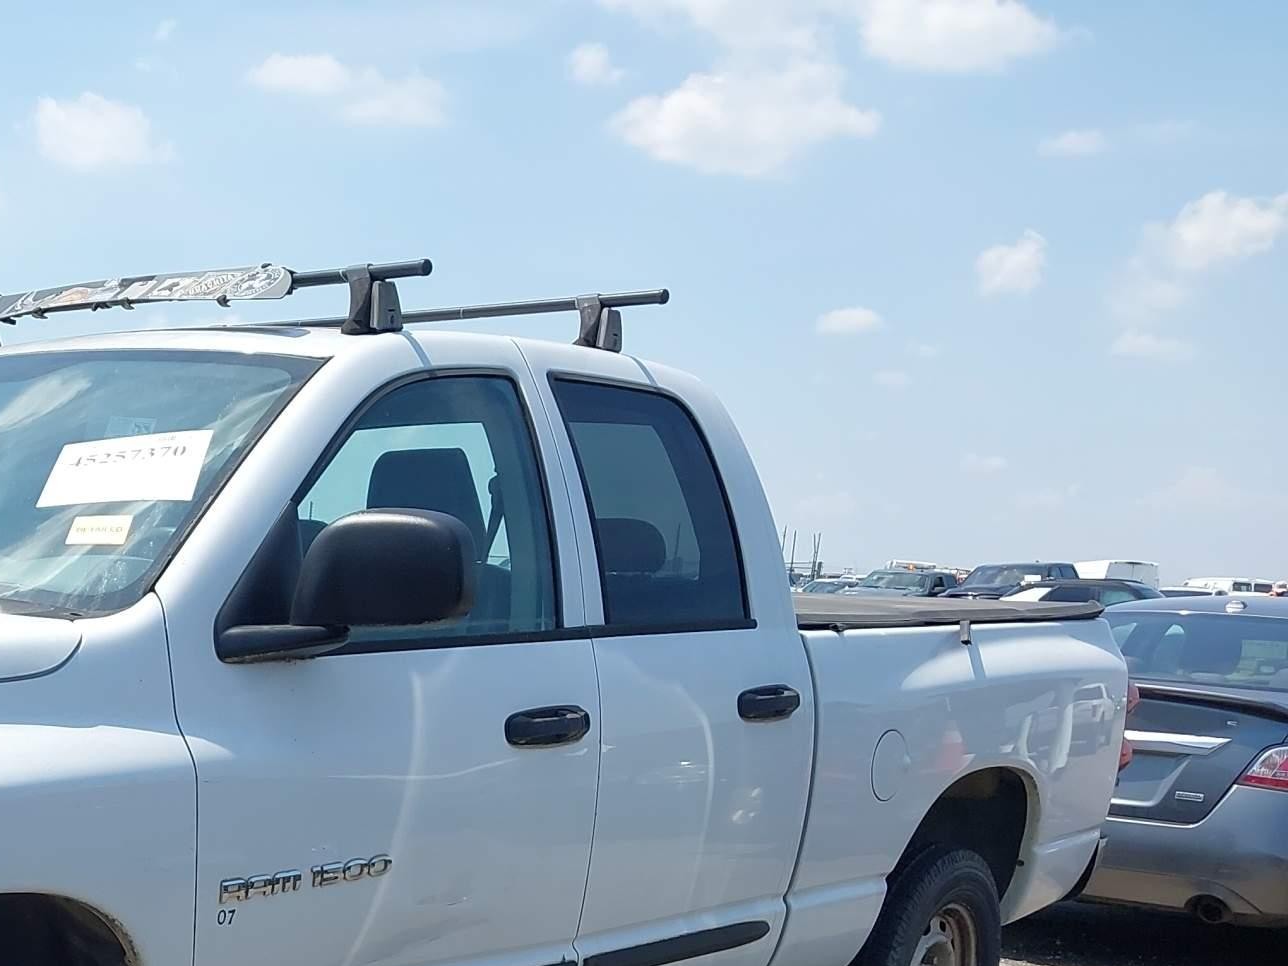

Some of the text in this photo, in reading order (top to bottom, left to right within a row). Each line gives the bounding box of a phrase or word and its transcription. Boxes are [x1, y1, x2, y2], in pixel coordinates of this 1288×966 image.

[69, 446, 187, 467] 45257370
[219, 853, 393, 904] RAM 1500
[216, 909, 236, 925] 07
